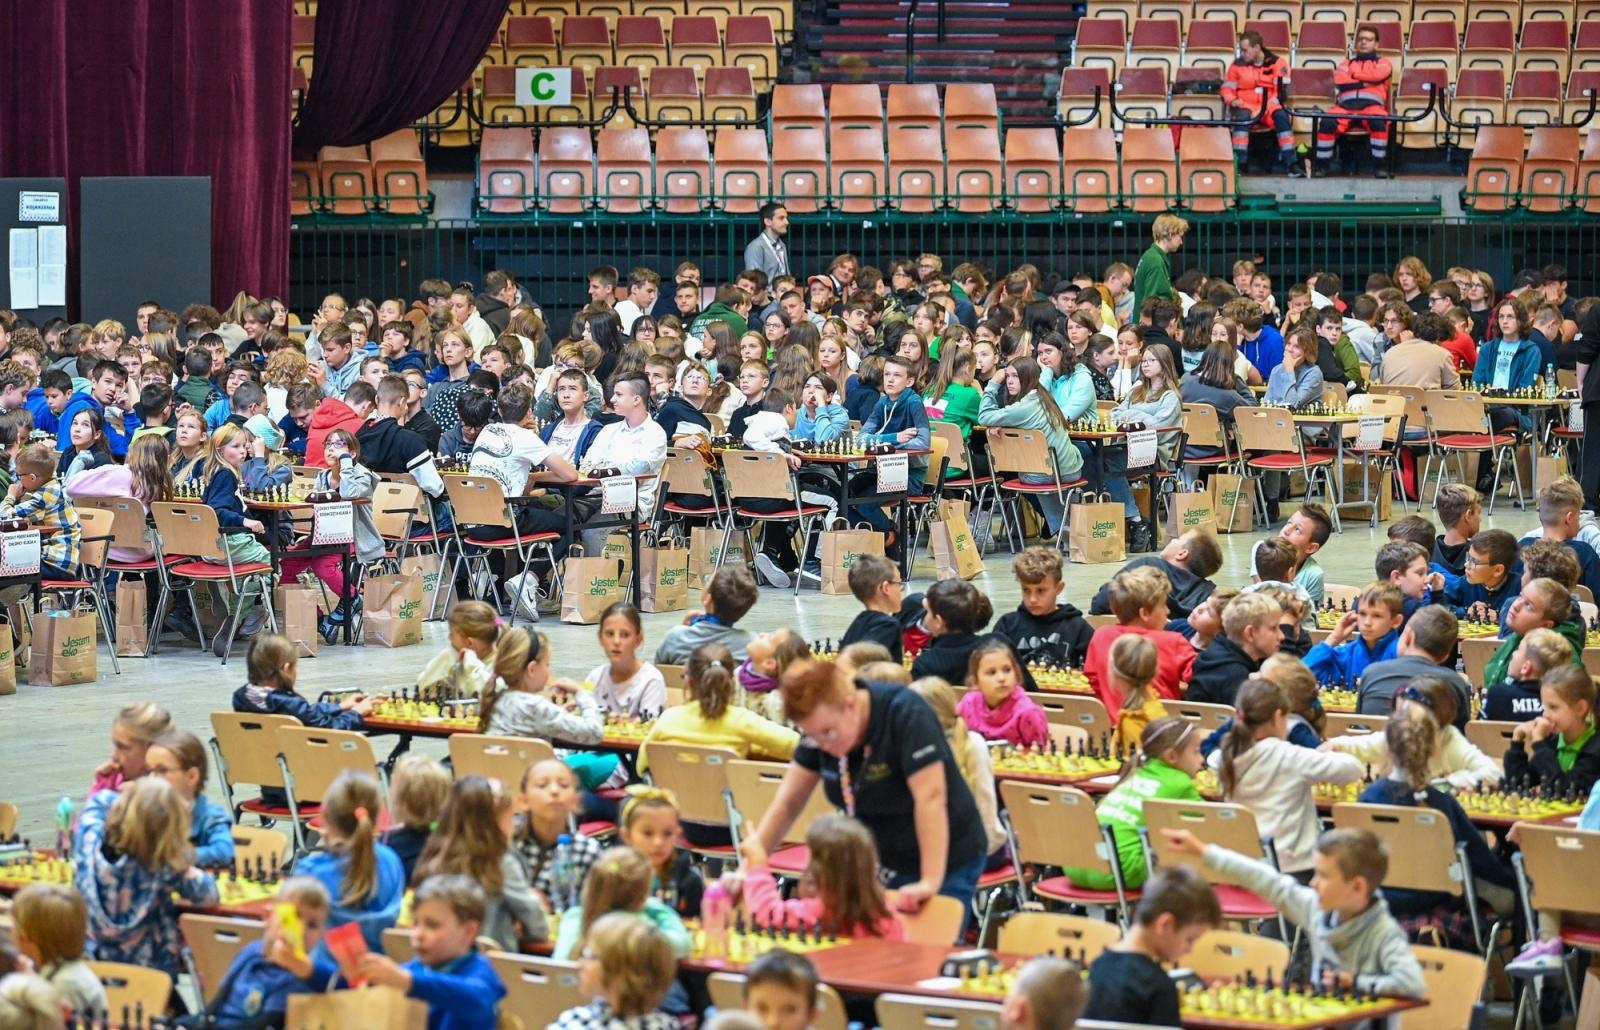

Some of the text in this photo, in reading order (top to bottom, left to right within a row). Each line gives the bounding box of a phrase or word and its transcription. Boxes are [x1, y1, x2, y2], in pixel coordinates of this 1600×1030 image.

[531, 72, 556, 101] C
[661, 576, 675, 586] eko
[590, 587, 607, 596] eko
[62, 635, 90, 648] Jestem
[62, 647, 78, 657] eko
